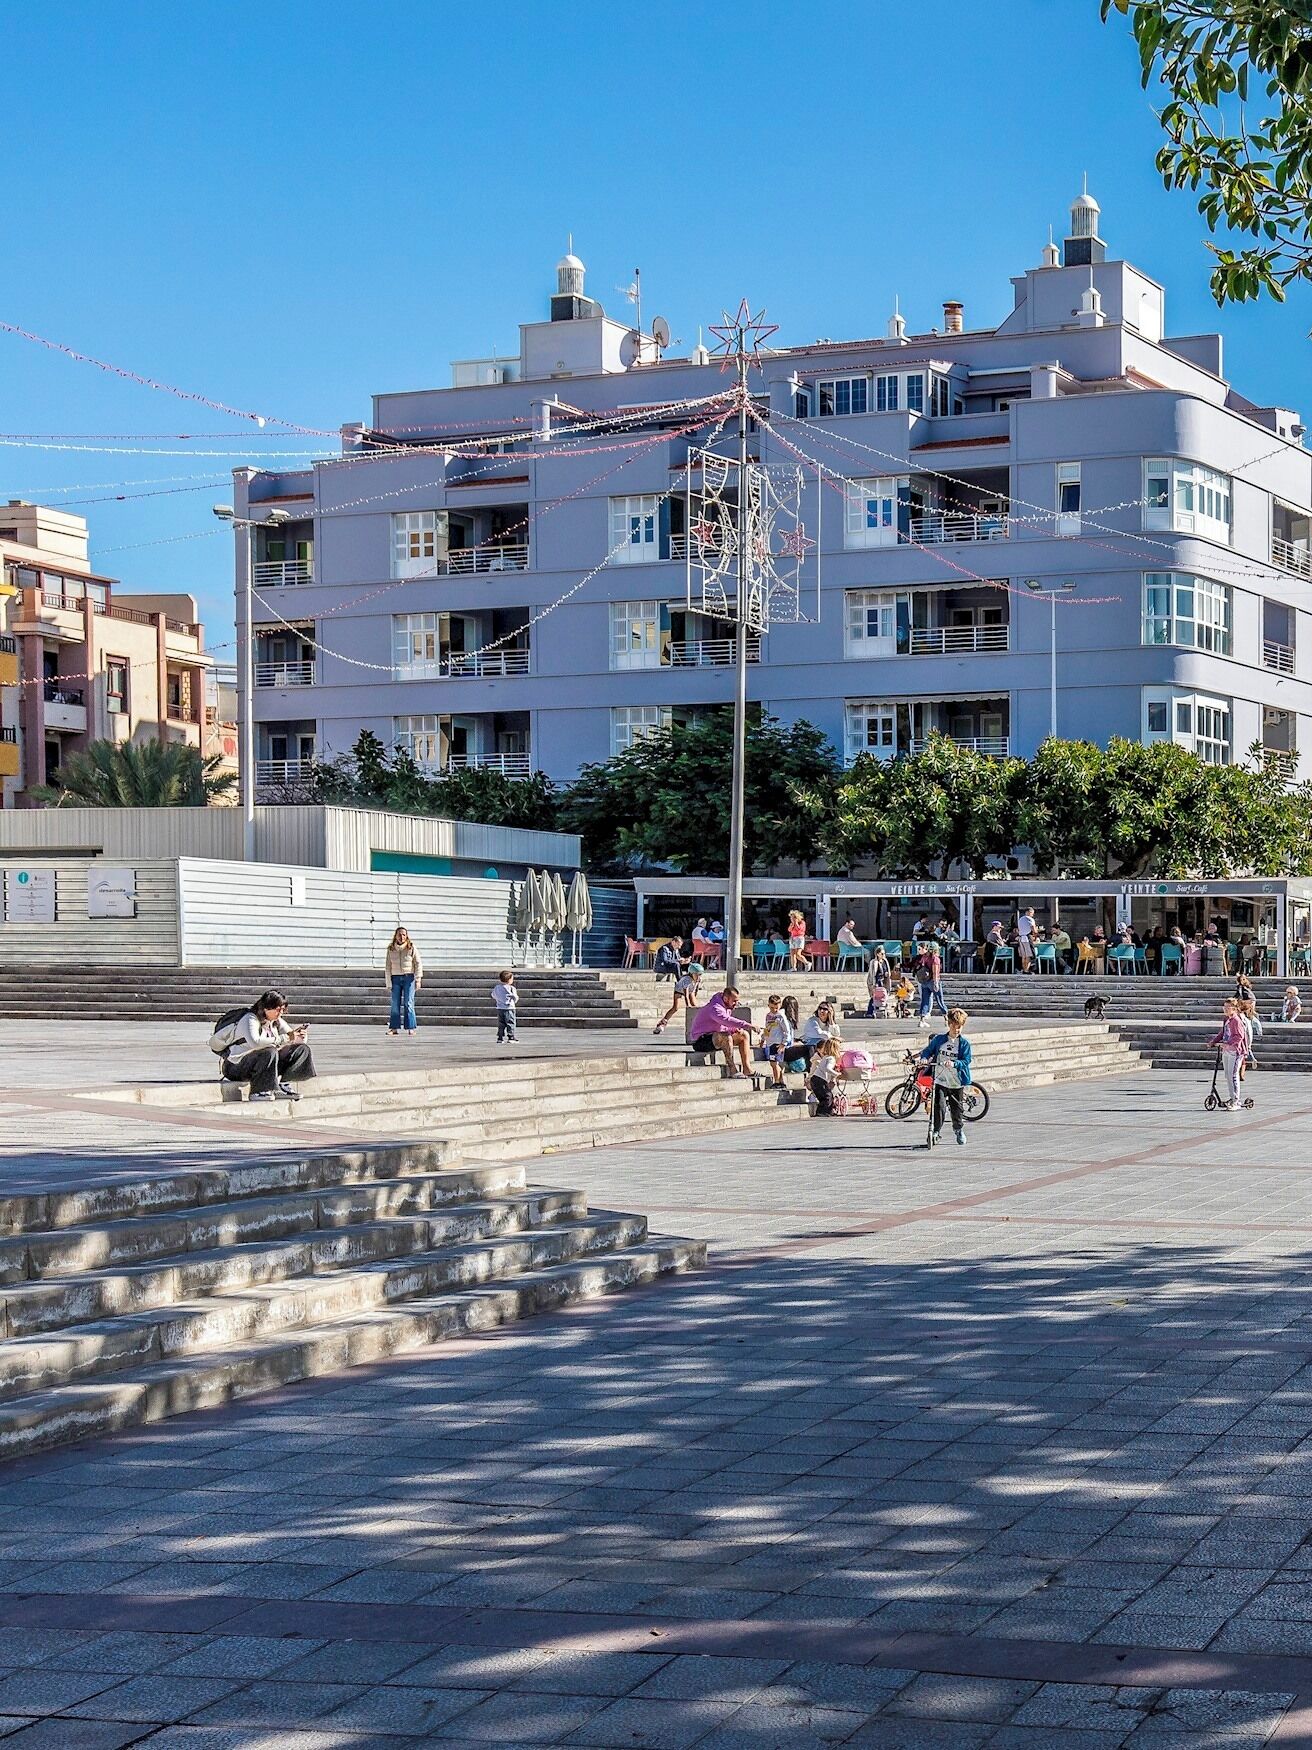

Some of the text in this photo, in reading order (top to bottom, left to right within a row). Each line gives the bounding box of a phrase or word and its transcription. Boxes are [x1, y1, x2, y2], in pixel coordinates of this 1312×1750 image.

[891, 885, 925, 894] VEINTE
[1121, 884, 1156, 894] VEINTE
[1176, 884, 1191, 894] Surf
